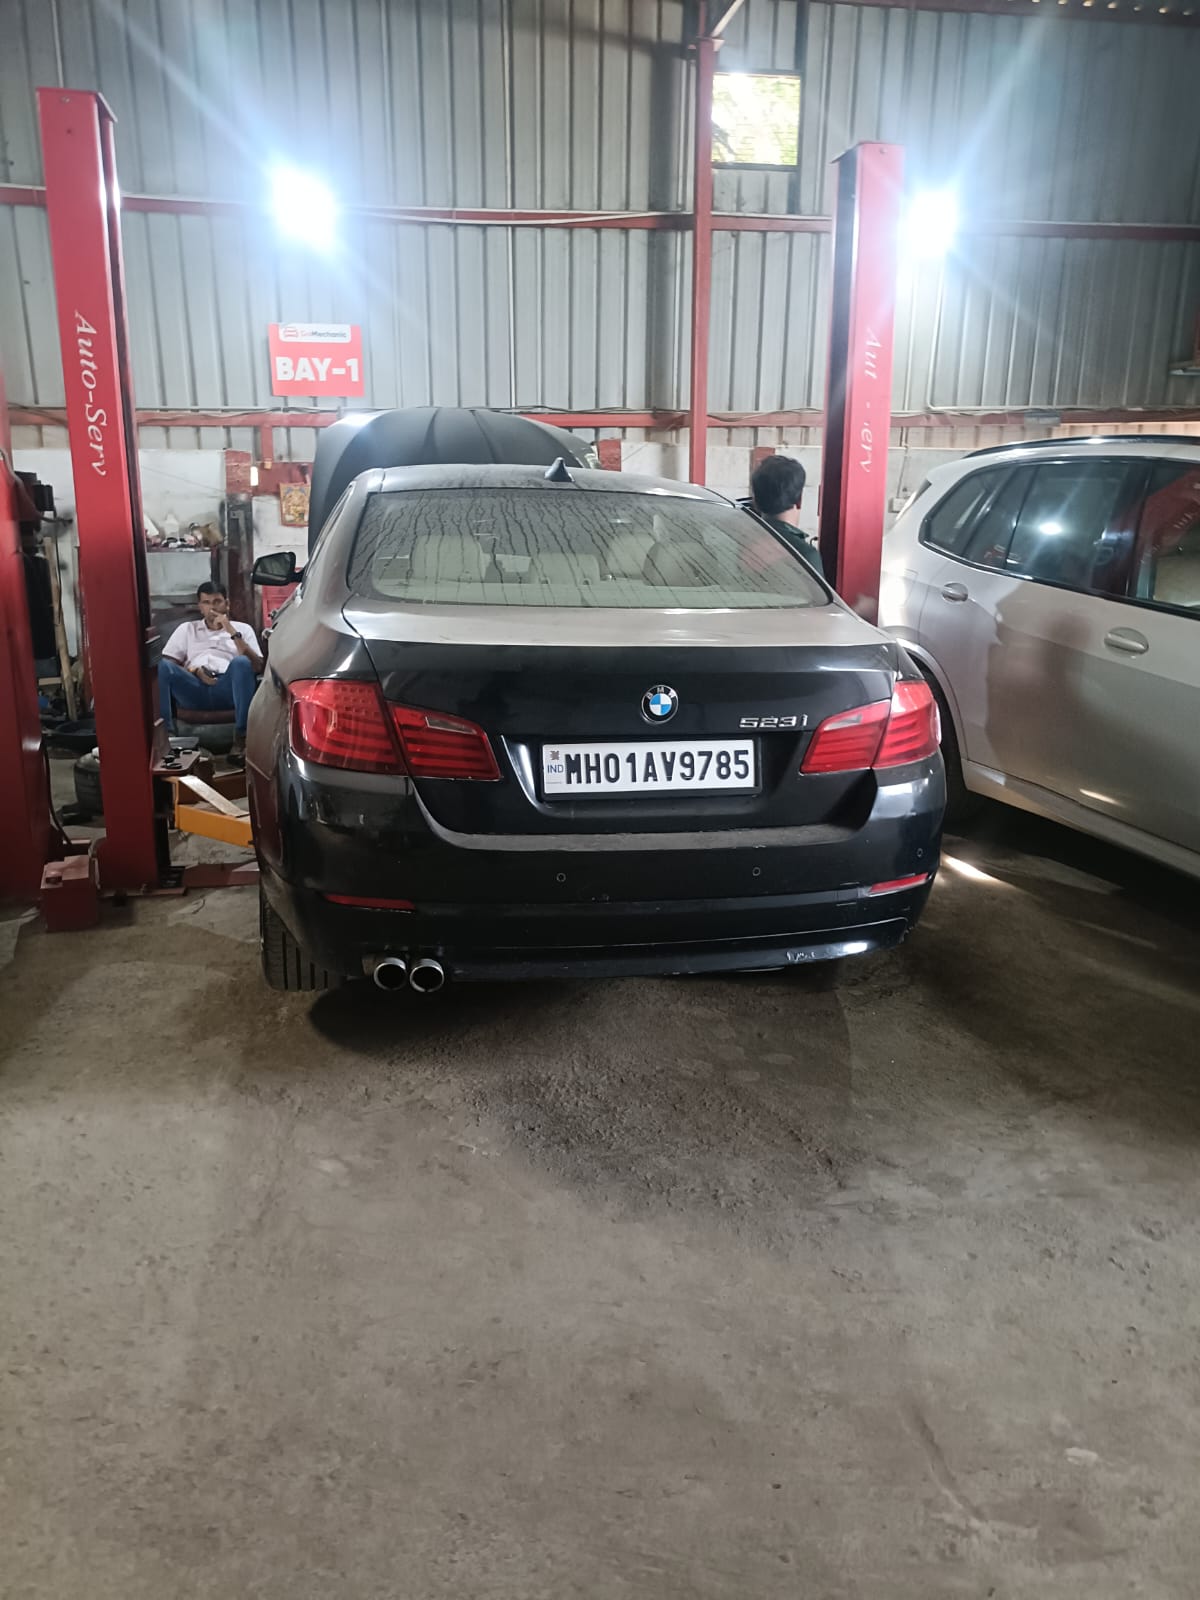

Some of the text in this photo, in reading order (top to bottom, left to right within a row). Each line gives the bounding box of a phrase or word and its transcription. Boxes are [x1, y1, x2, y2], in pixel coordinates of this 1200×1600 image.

[275, 356, 359, 382] BAY-1
[74, 310, 107, 477] Auto-Serv
[739, 714, 808, 728] 523i
[547, 764, 564, 774] IND
[565, 750, 750, 785] MH01AV9785
